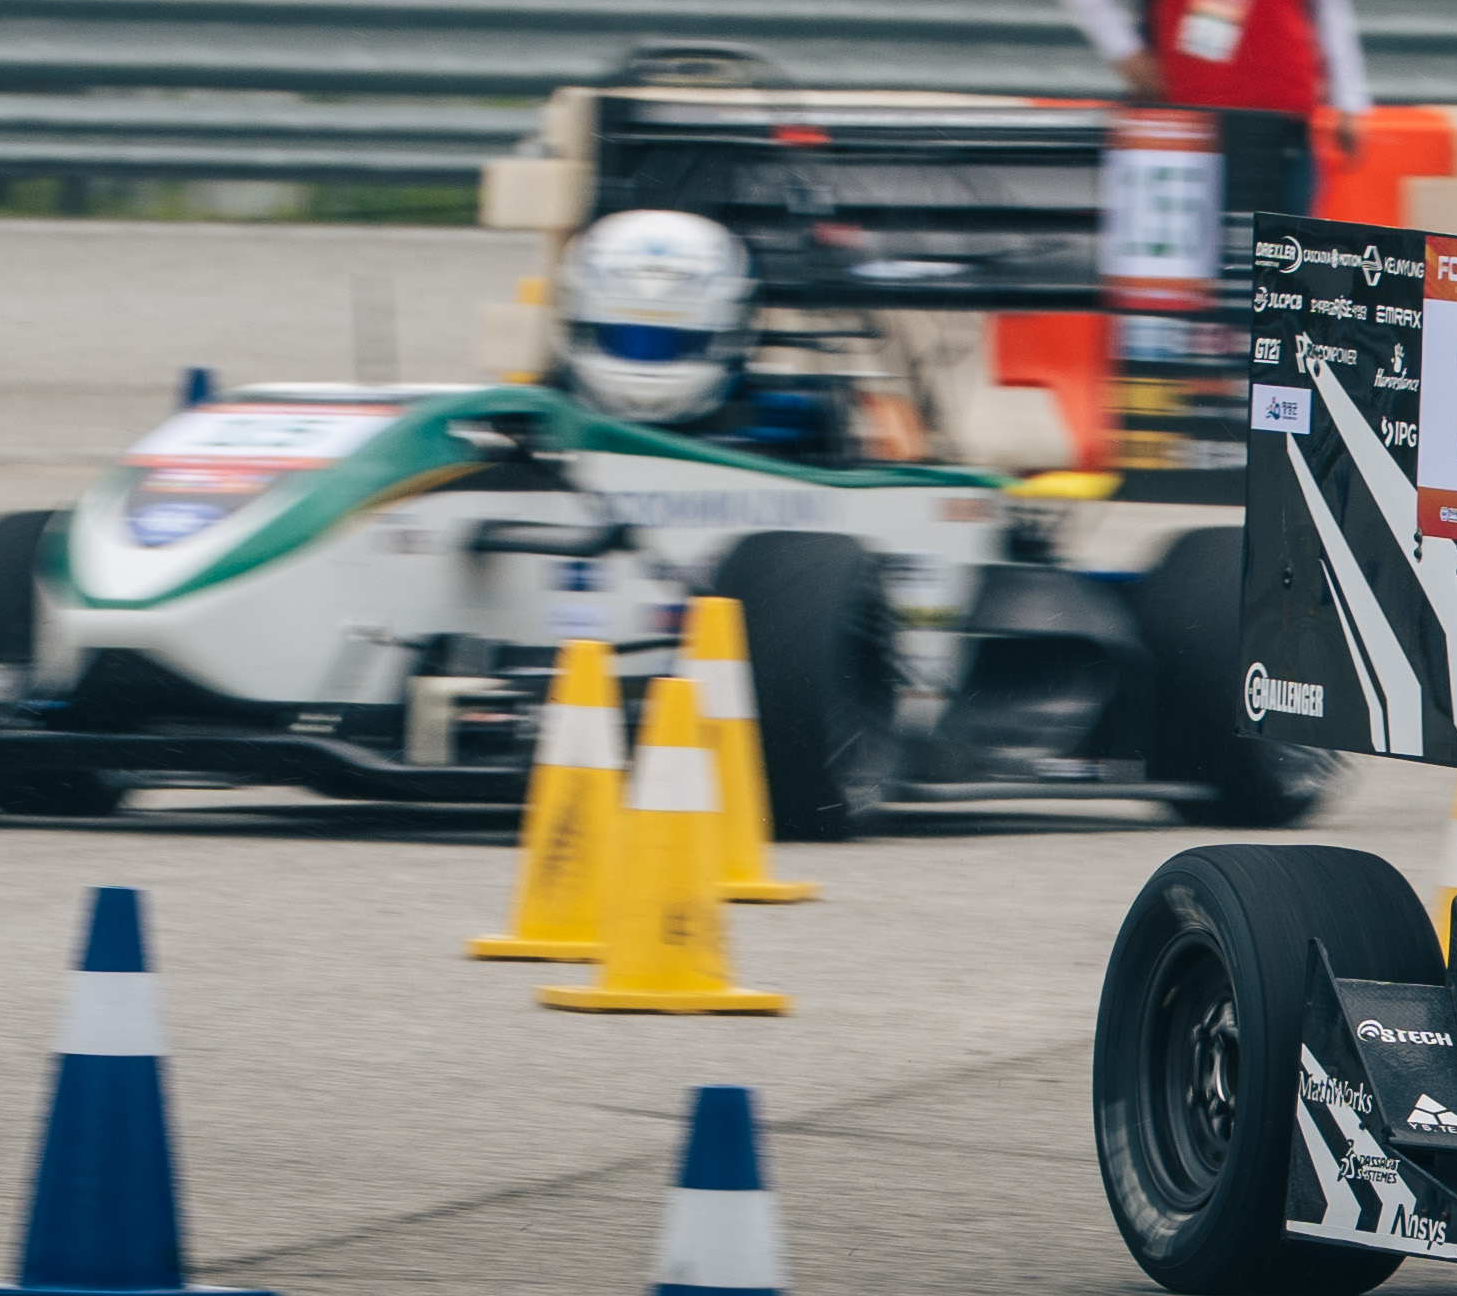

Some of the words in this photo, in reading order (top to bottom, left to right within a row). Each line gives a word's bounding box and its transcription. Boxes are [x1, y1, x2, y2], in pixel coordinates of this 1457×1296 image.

[1267, 292, 1303, 310] JLCPCB
[1375, 305, 1422, 329] EMRAX
[1395, 421, 1417, 448] IPG
[1251, 674, 1324, 718] CHALLENGER
[1299, 1071, 1373, 1114] MathWorks
